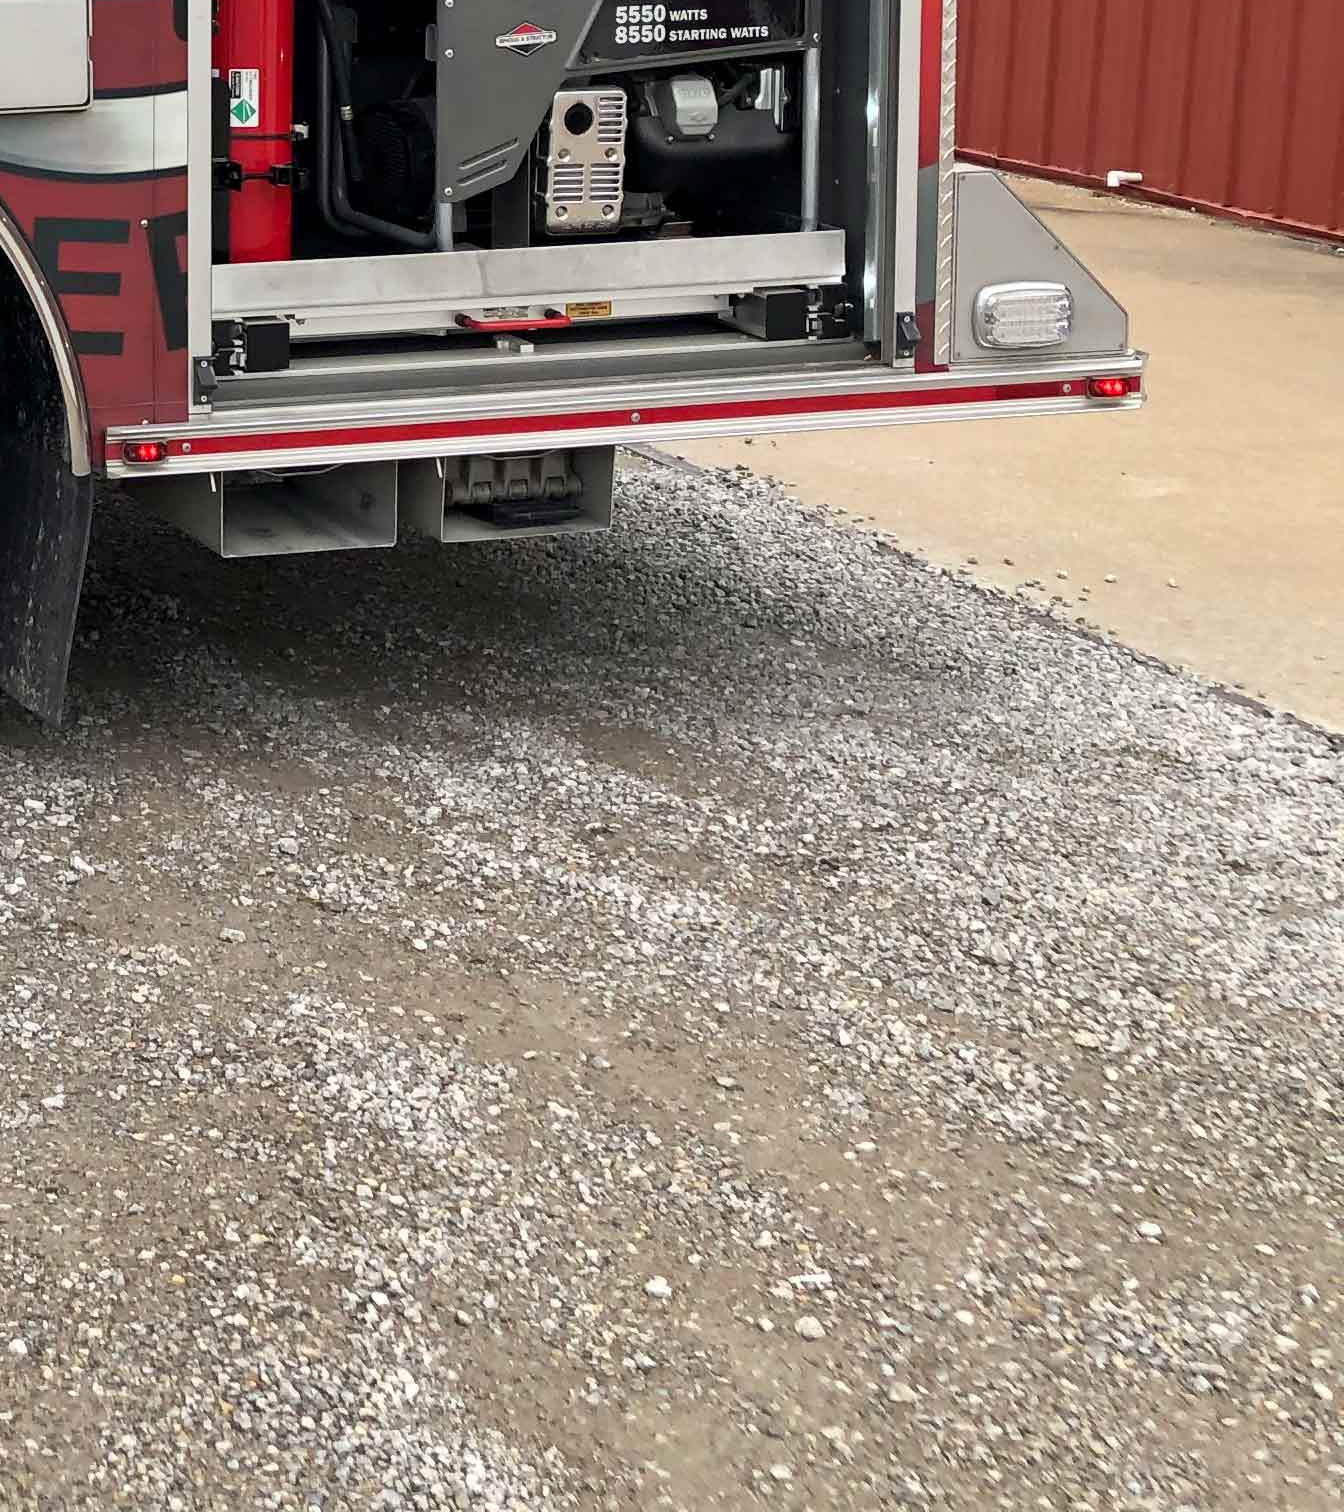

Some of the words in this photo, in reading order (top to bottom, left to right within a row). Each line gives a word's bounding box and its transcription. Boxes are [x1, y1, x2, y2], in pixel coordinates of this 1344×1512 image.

[614, 4, 666, 25] 5550
[669, 9, 708, 22] WATTS
[614, 24, 666, 45] 8550
[668, 28, 727, 42] STARTING
[730, 26, 770, 39] WATTS
